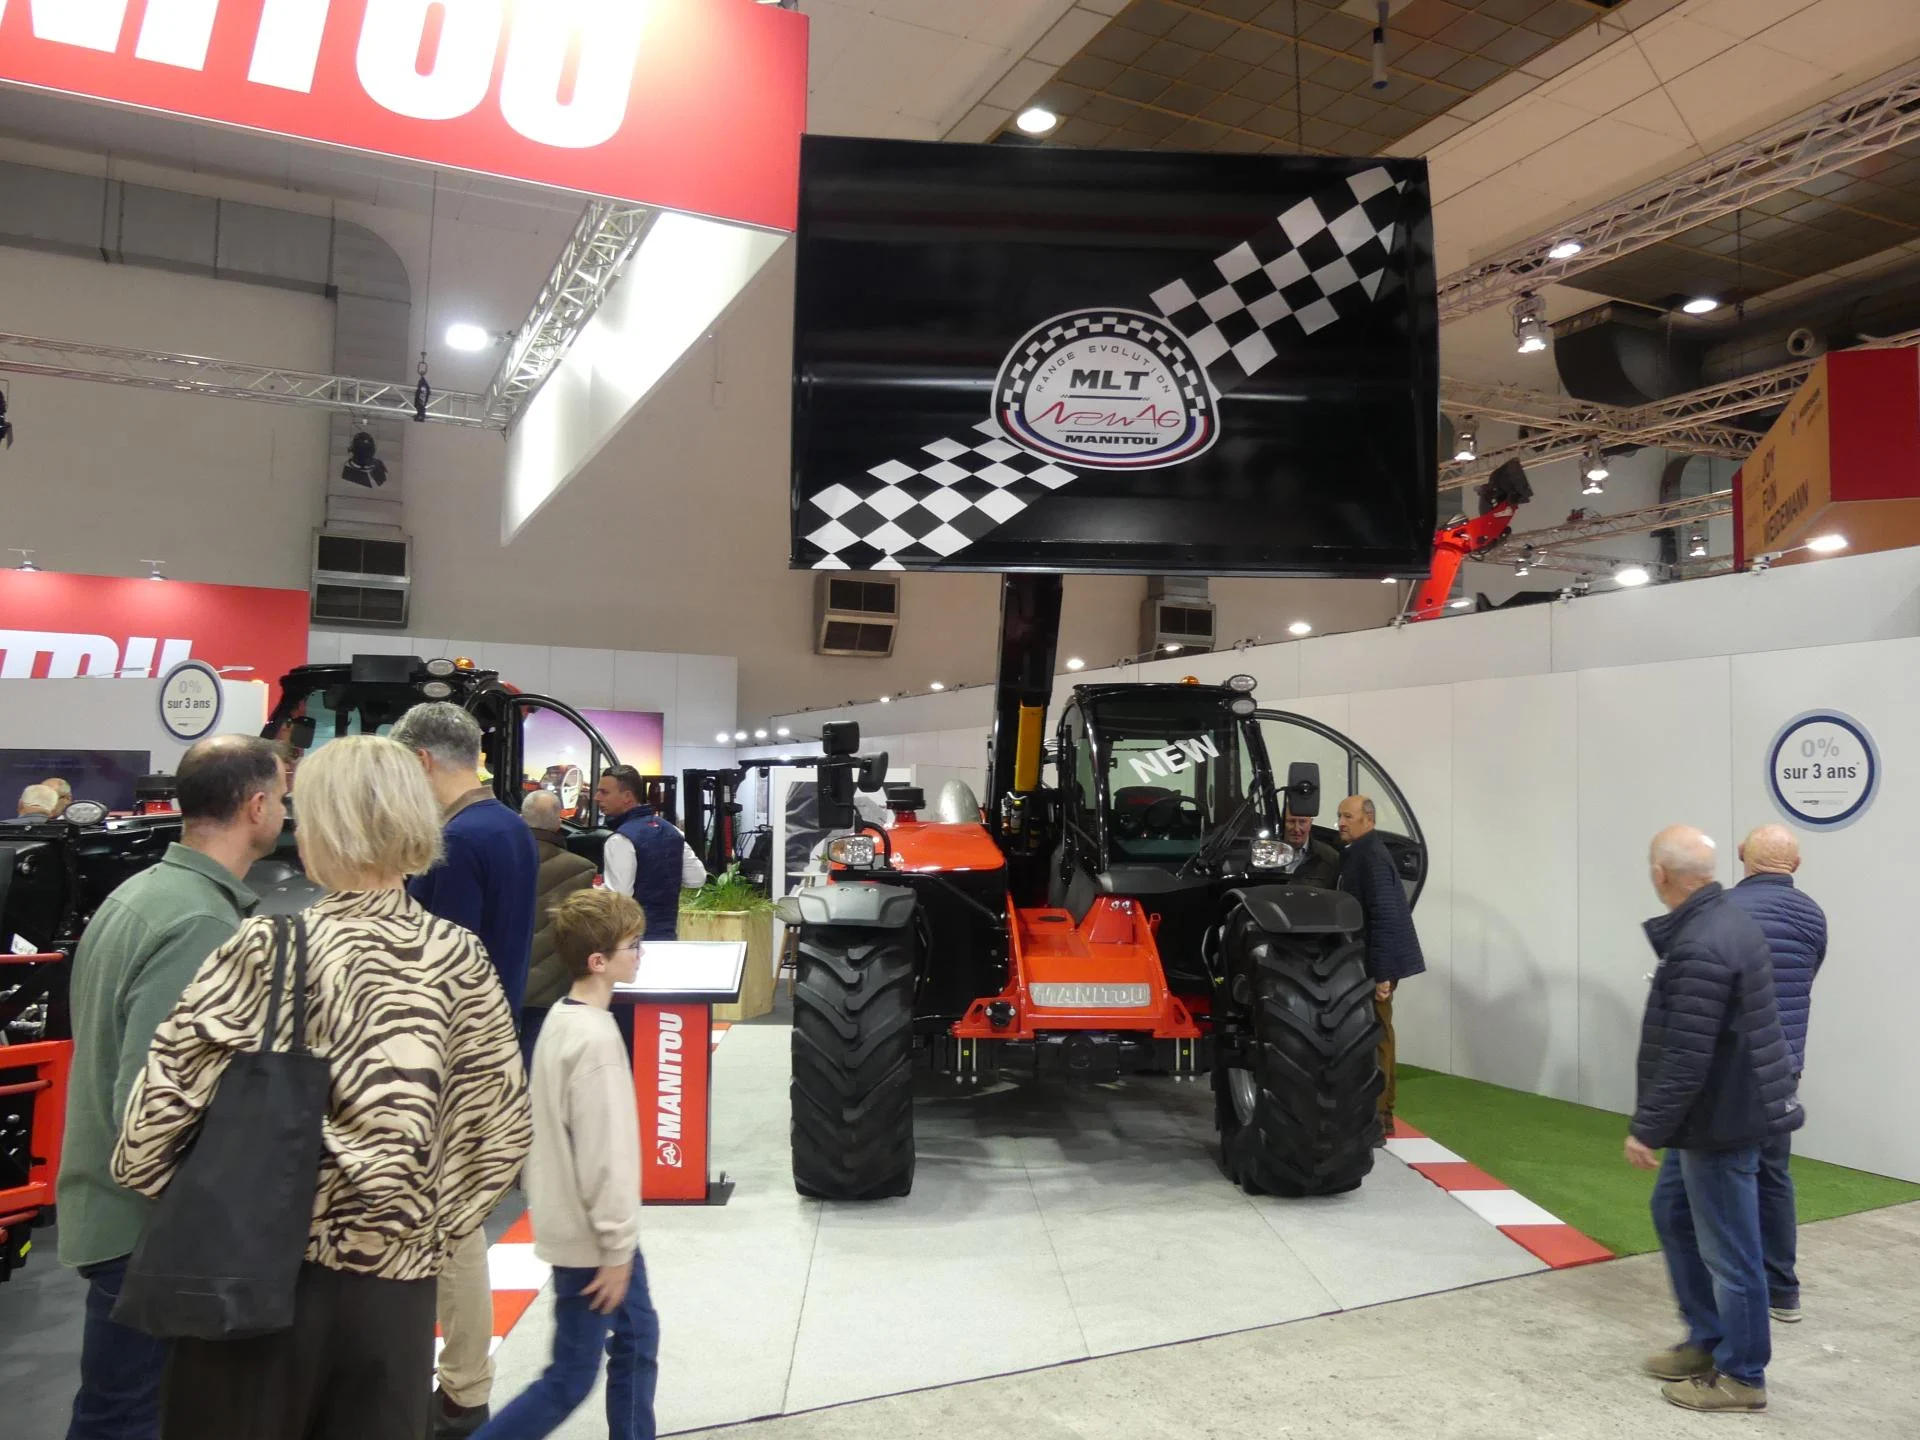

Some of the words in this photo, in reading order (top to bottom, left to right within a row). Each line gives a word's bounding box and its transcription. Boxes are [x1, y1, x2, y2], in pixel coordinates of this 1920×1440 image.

[1036, 351, 1076, 393] RANGE
[1088, 345, 1171, 394] EVOLUTION
[1069, 369, 1149, 391] MLT
[1065, 435, 1158, 445] MANITOU
[179, 680, 202, 693] 0%
[167, 700, 183, 708] sur
[185, 697, 191, 708] 3
[1801, 737, 1840, 757] 0%
[1128, 734, 1220, 784] NEW
[1783, 767, 1808, 779] sur
[1813, 763, 1822, 779] 3
[658, 1012, 683, 1140] MANITOU
